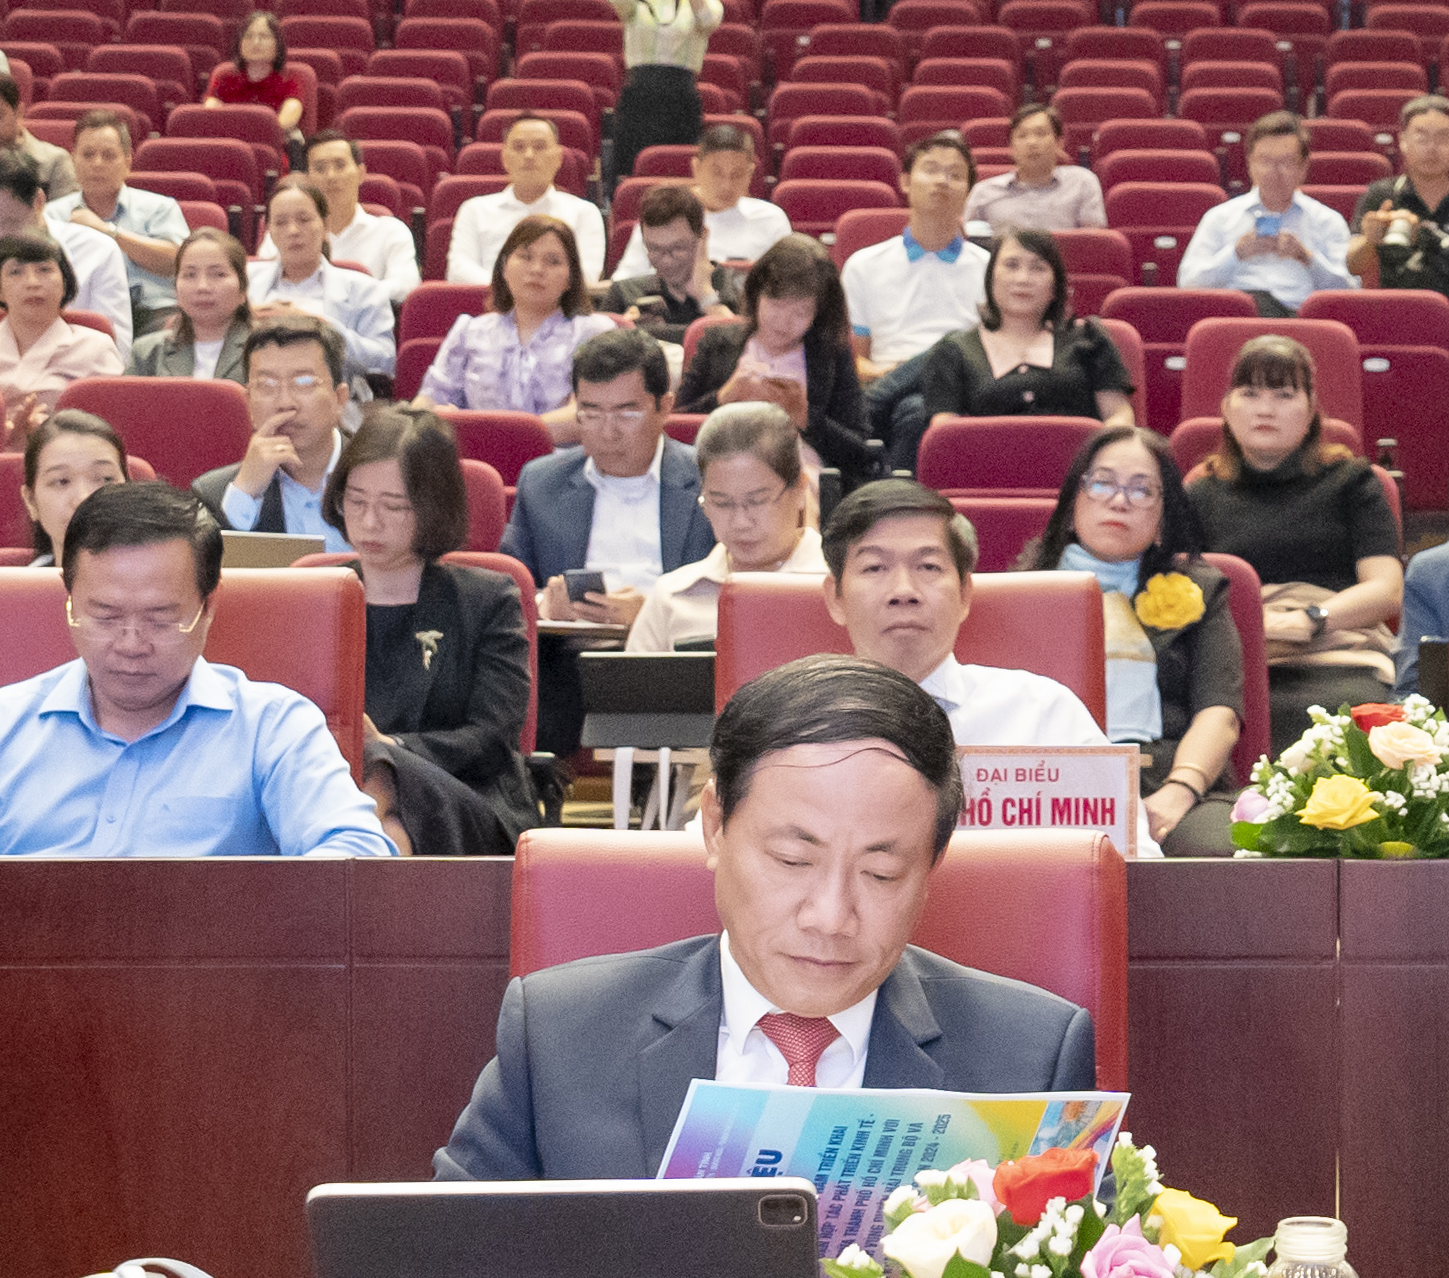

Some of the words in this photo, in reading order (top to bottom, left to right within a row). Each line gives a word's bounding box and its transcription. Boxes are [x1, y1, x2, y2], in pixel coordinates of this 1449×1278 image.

[976, 768, 1008, 785] ĐẠI
[1015, 759, 1060, 782] BIỂU
[1001, 790, 1042, 827] CHÍ
[1051, 797, 1116, 827] MINH
[830, 1125, 849, 1146] KHAI
[850, 1130, 872, 1153] KINH
[873, 1134, 895, 1158] MINH
[921, 1141, 941, 1164] 2024
[932, 1114, 952, 1136] 2025
[746, 1148, 784, 1178] ỆU
